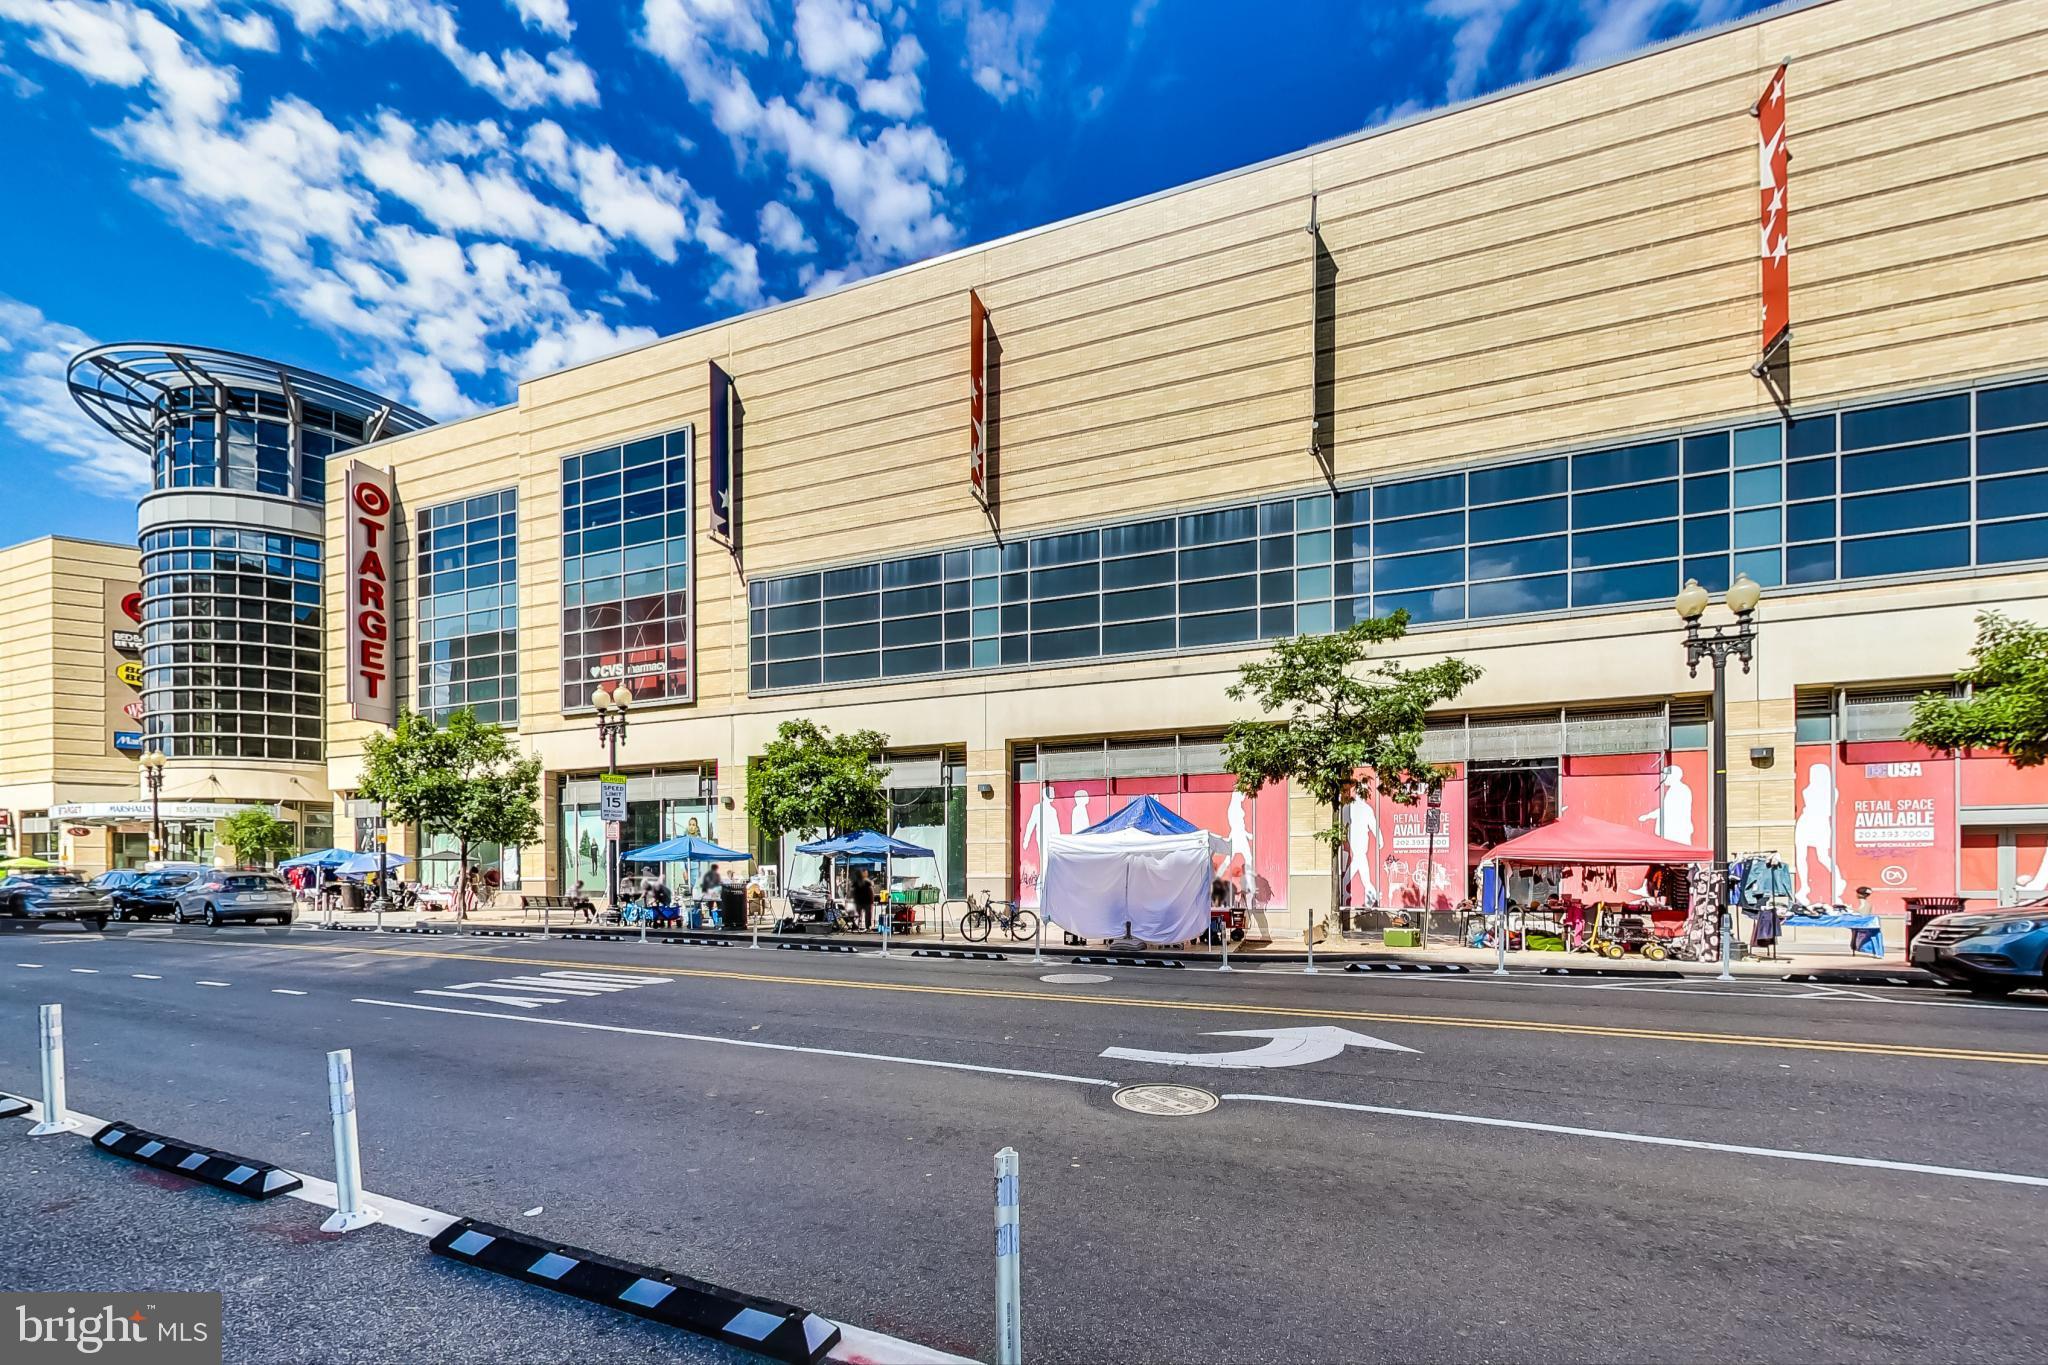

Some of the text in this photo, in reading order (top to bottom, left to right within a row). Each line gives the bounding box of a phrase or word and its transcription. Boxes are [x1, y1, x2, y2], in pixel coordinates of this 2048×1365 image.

[358, 517, 387, 699] TARGET
[600, 663, 624, 678] CVS
[606, 797, 621, 808] 15
[1855, 799, 1935, 811] RETAIL SPACE
[1394, 813, 1420, 823] RETAIL
[1855, 811, 1935, 827] AVAILABLE
